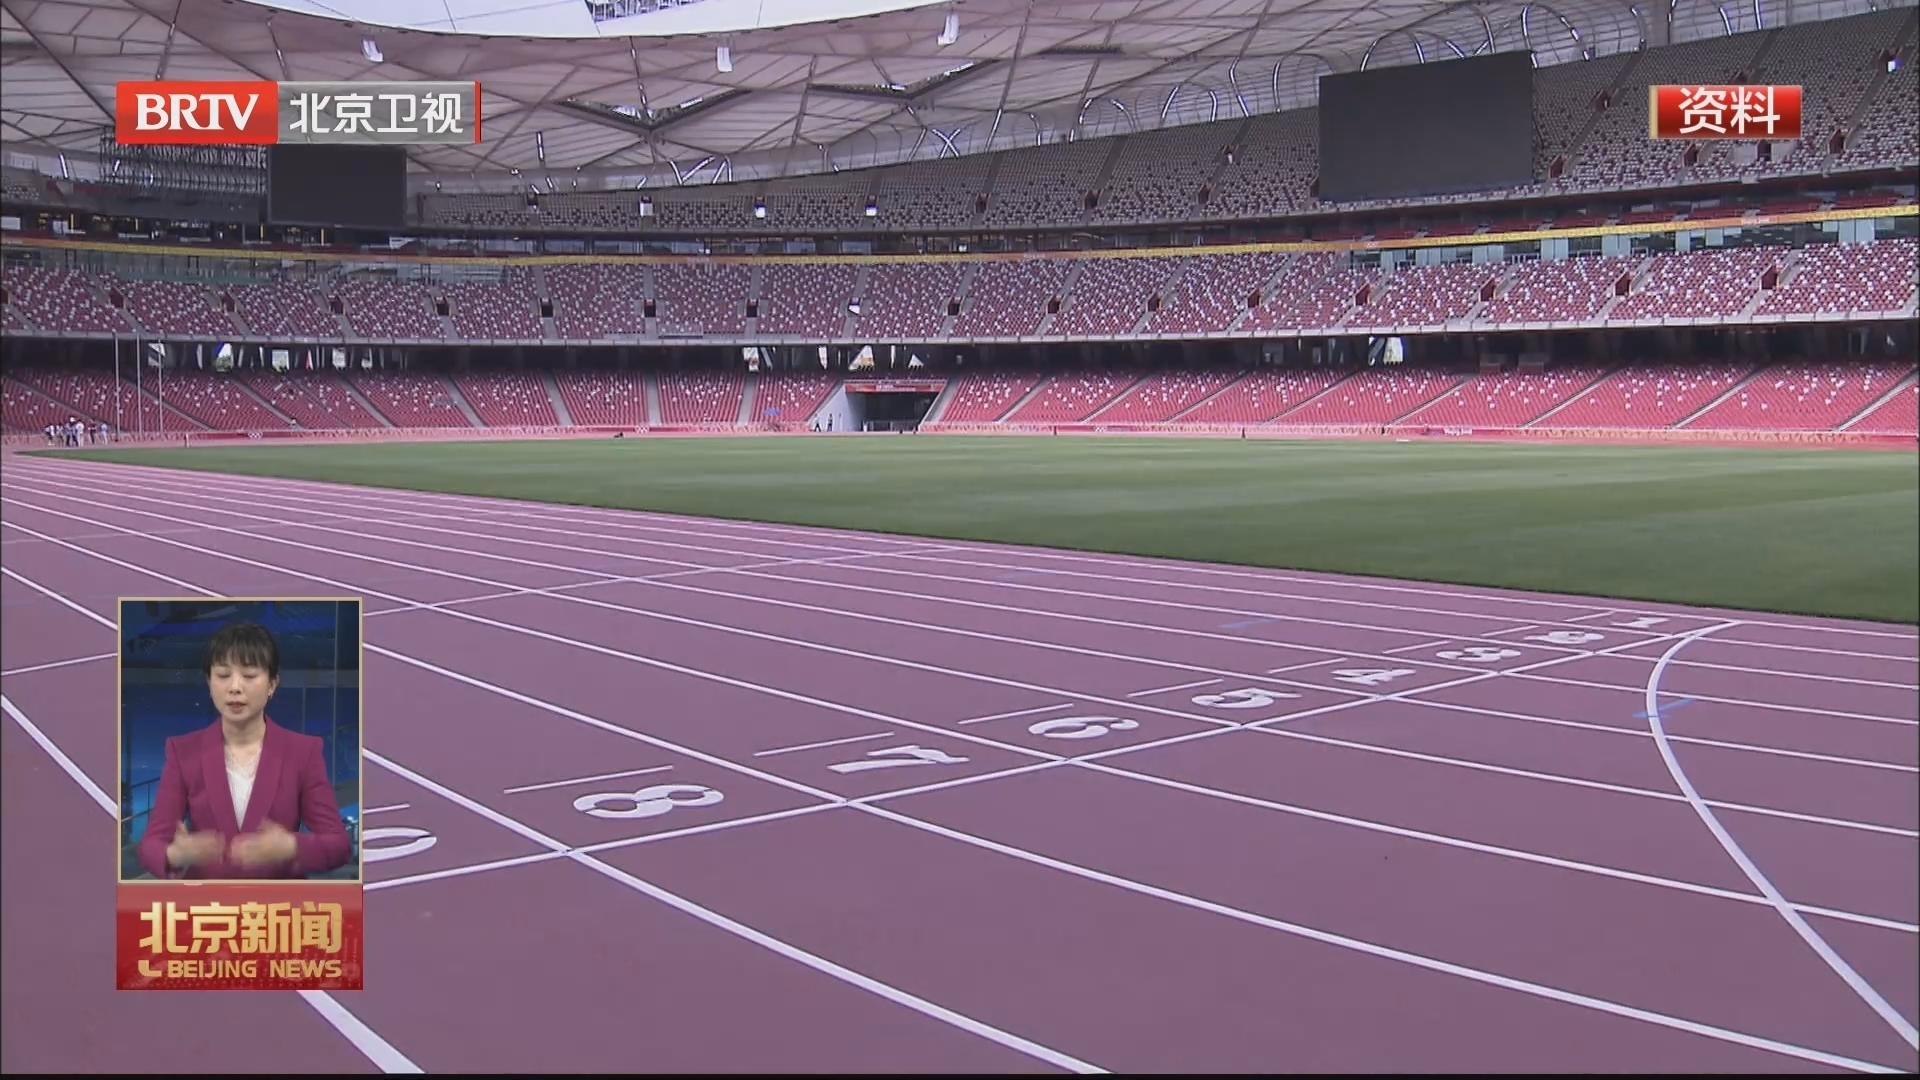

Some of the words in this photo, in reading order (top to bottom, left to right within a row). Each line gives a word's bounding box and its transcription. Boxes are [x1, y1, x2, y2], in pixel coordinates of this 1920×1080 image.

[1435, 647, 1521, 662] 3
[1330, 668, 1417, 685] 4
[1191, 687, 1302, 708] 5
[1028, 716, 1139, 739] 6
[826, 744, 970, 774] 7
[572, 783, 725, 819] 8
